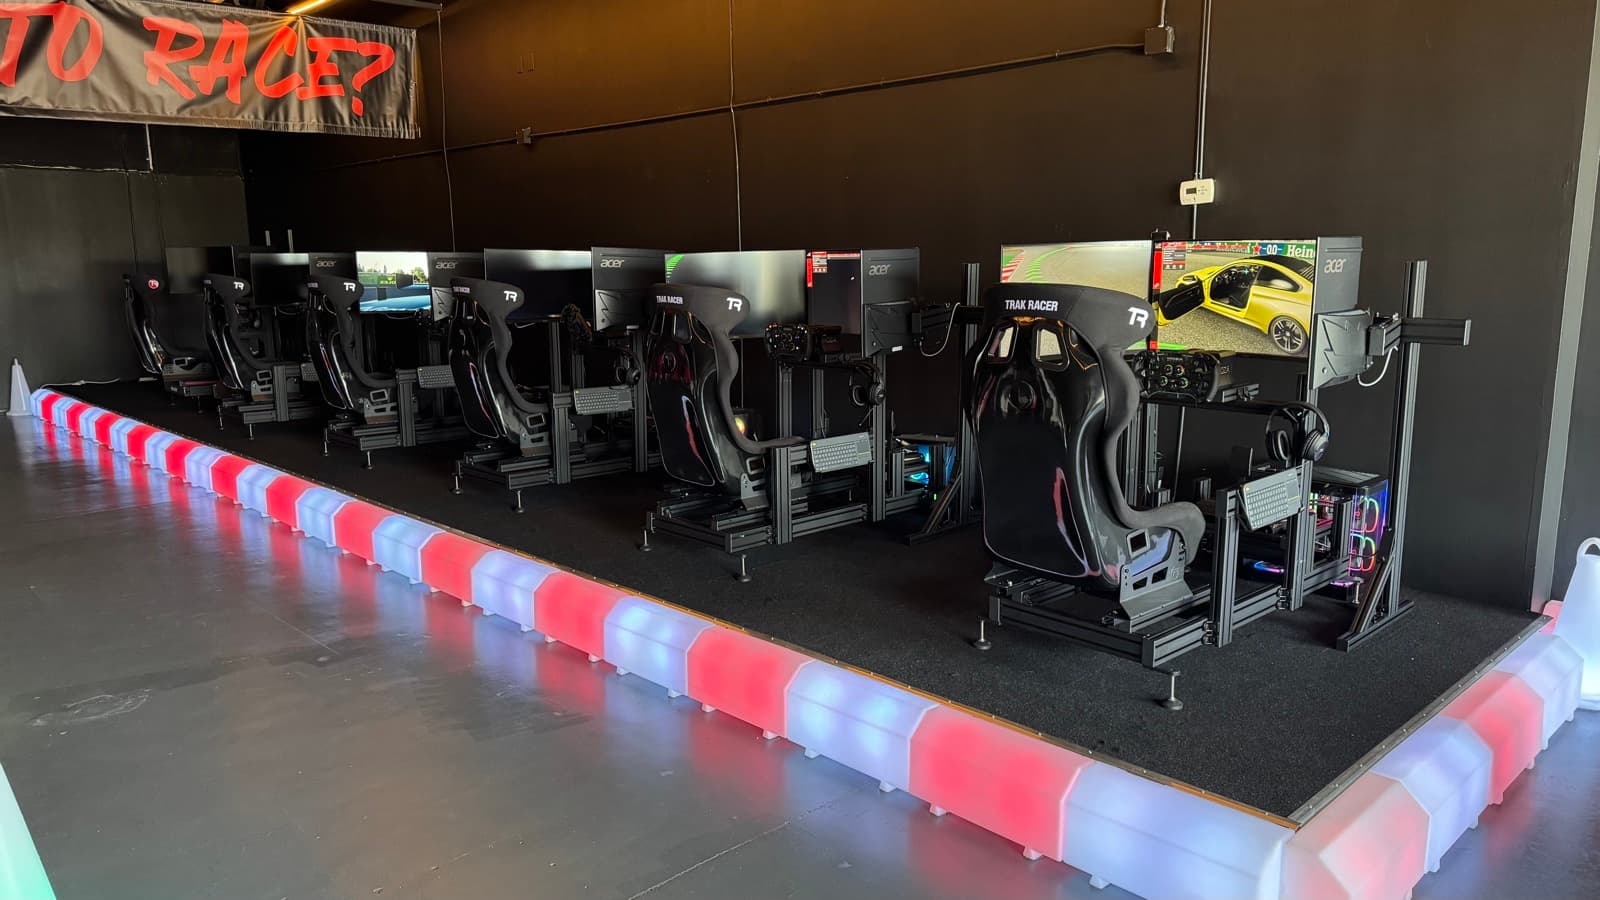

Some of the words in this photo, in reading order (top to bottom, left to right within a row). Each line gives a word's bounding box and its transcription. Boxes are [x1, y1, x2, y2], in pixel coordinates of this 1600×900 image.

[143, 16, 395, 117] RACE?
[1287, 244, 1315, 258] Hein
[316, 260, 336, 268] acer
[436, 261, 458, 269] acer
[600, 259, 624, 268] acer
[868, 264, 891, 276] acer
[1324, 258, 1347, 274] acer
[503, 290, 518, 302] TR
[726, 297, 743, 312] TR
[1005, 299, 1026, 310] TRAK
[1028, 300, 1059, 312] RACER
[1127, 306, 1149, 329] TR
